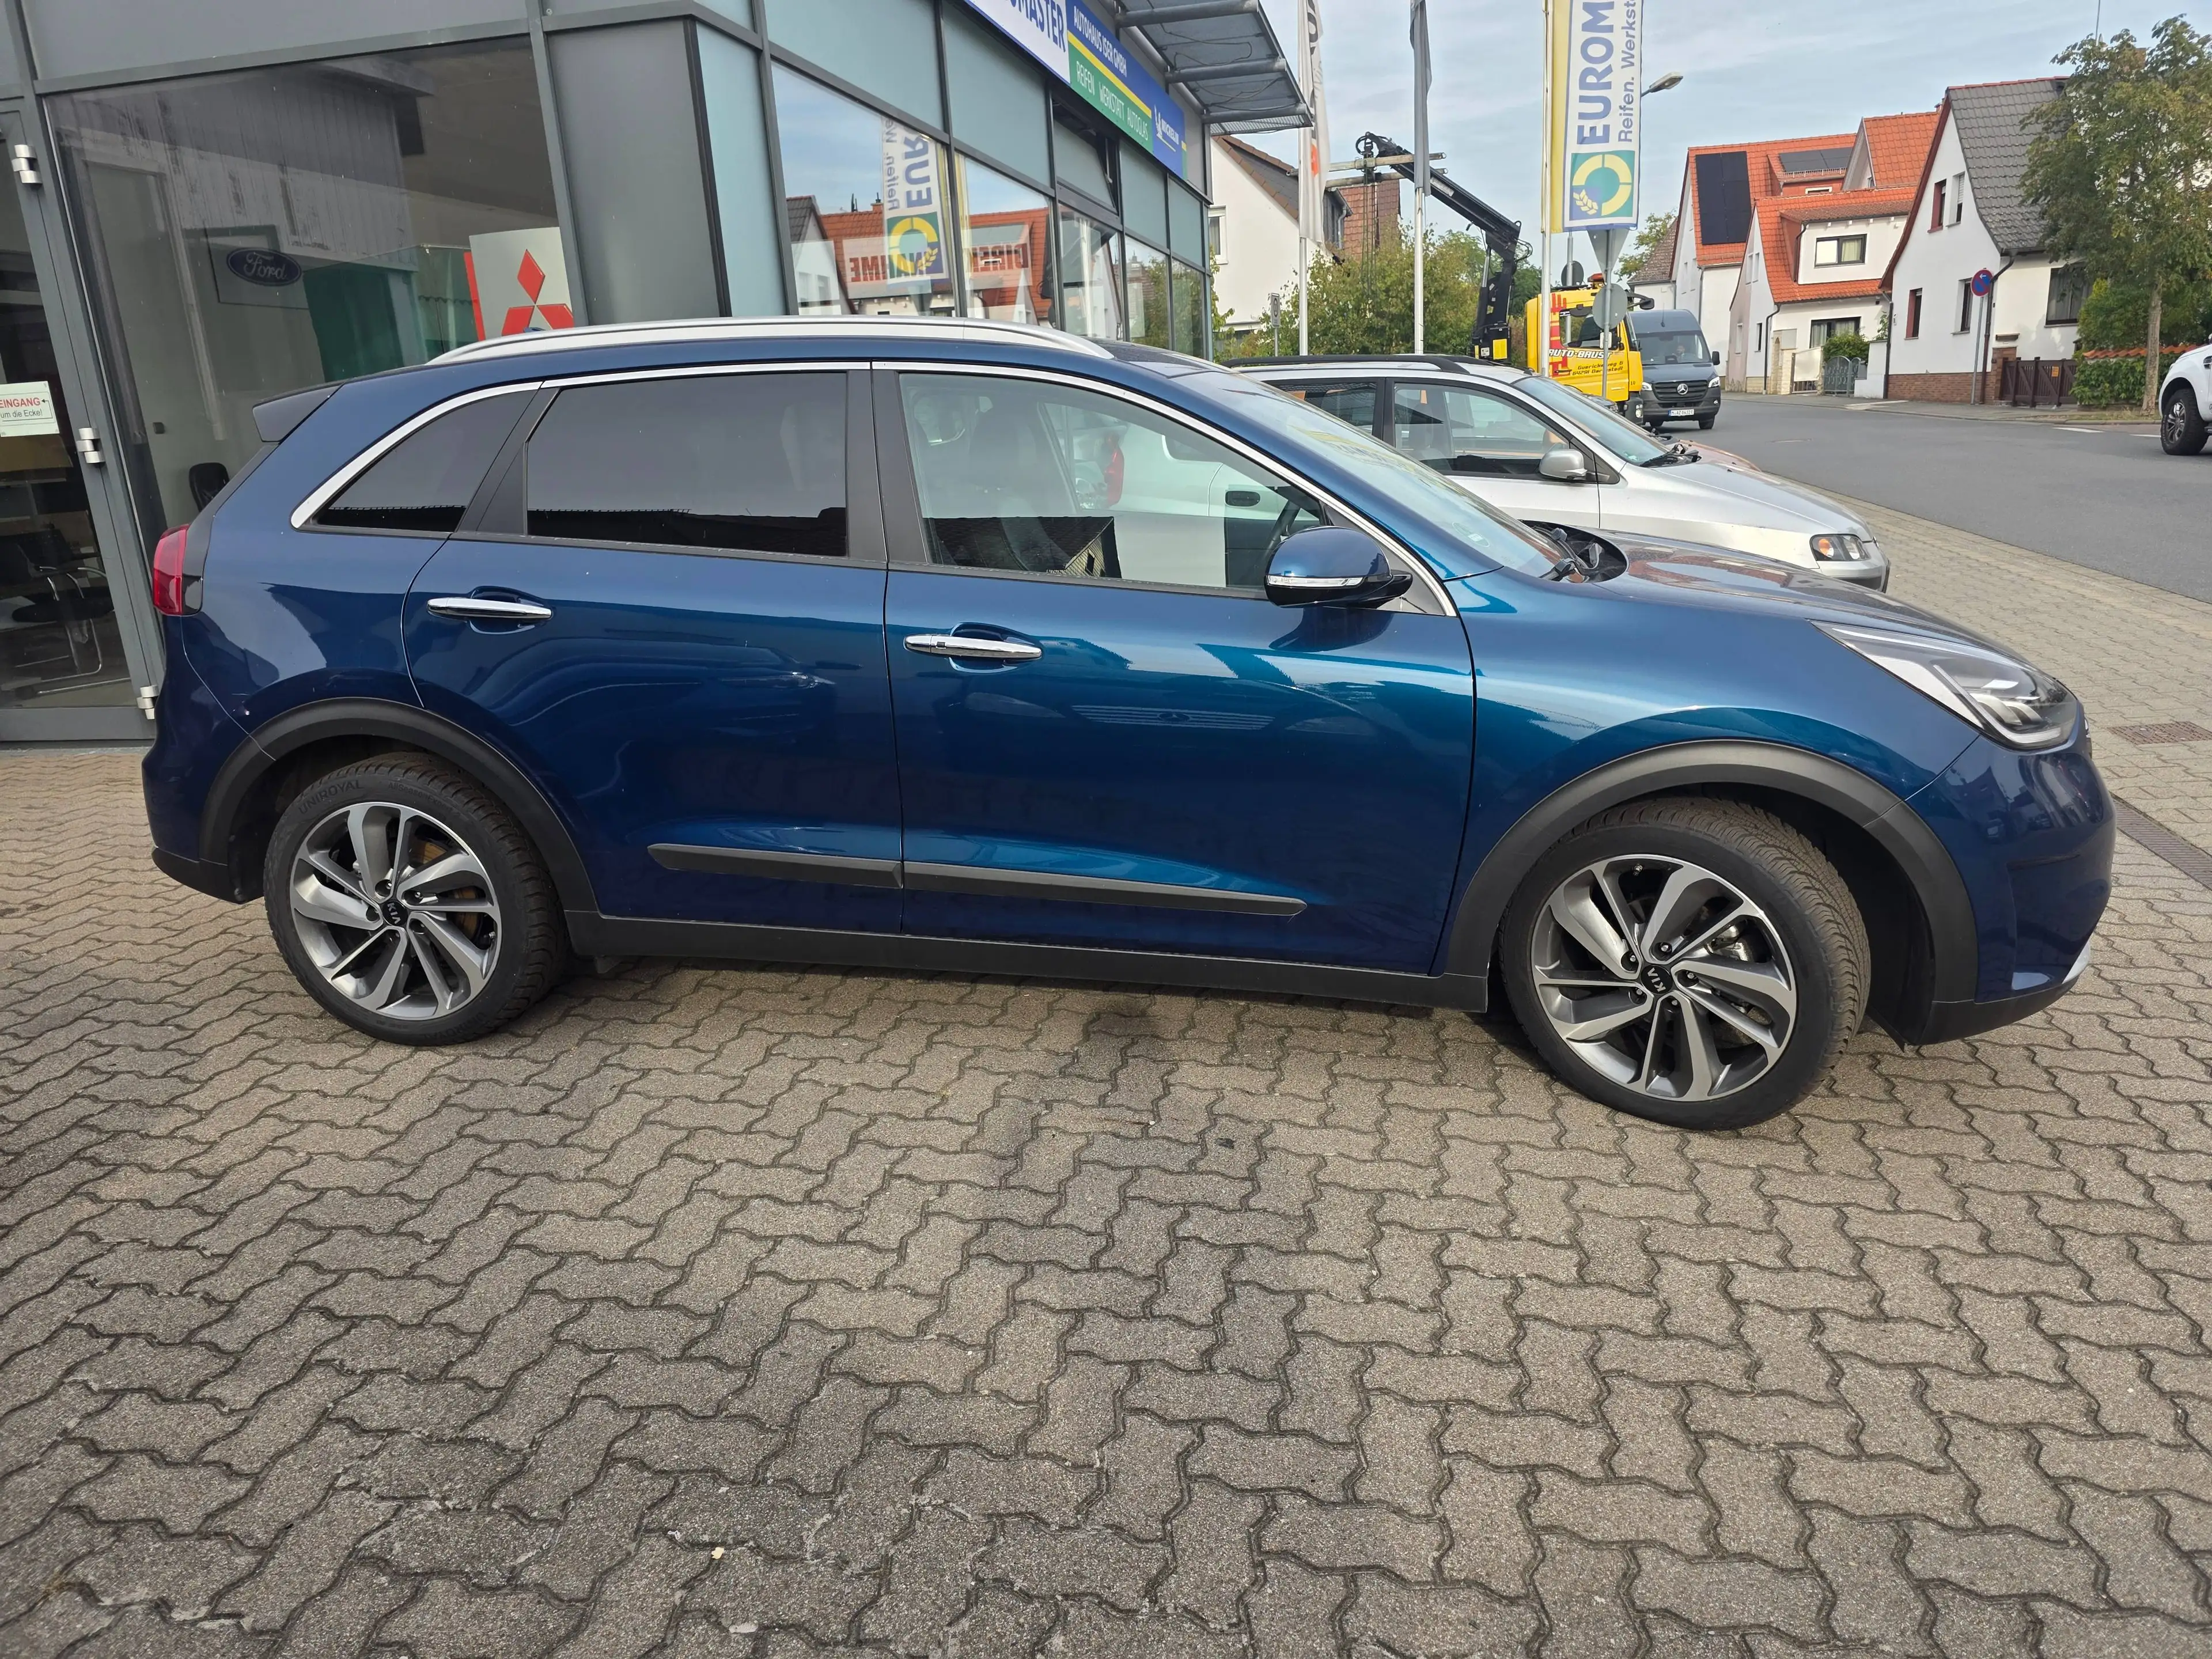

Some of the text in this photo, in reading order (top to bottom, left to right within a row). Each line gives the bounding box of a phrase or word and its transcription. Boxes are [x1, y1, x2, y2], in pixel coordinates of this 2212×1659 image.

[1073, 5, 1103, 52] AUTOHAUS
[1618, 0, 1637, 142] Reifen. Werkst
[1076, 60, 1149, 141] REIFEN WERKSTATT AUTOGLAS
[1161, 118, 1179, 145] MICHELIN
[243, 251, 288, 280] Ford
[1592, 366, 1623, 374] Darstadt
[0, 397, 41, 408] EINGANG
[298, 779, 365, 815] UNIROYAL
[387, 902, 401, 925] KIA
[1647, 967, 1666, 992] KIA
